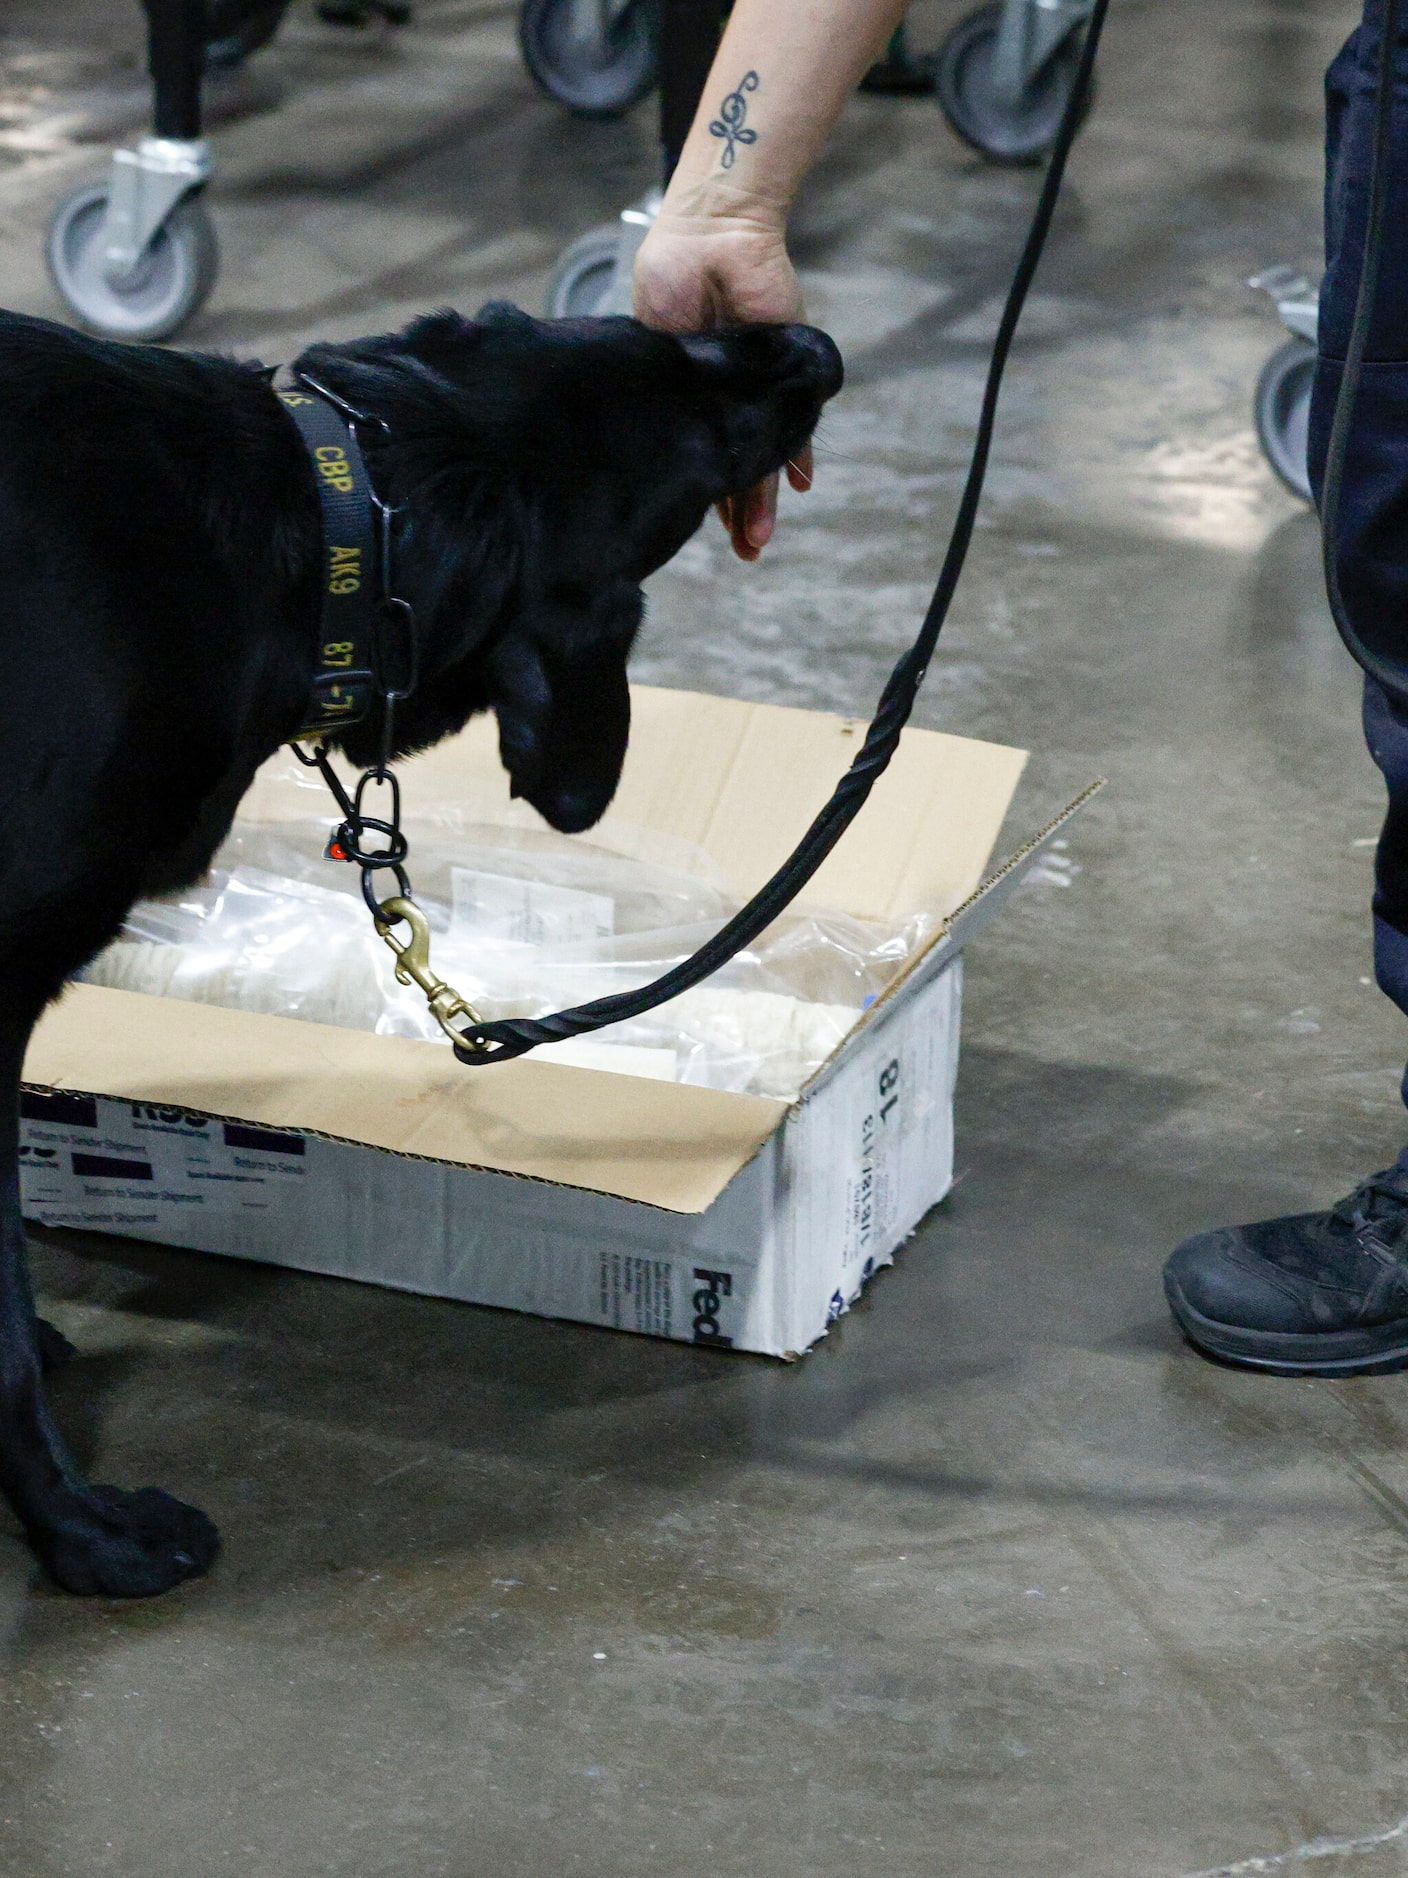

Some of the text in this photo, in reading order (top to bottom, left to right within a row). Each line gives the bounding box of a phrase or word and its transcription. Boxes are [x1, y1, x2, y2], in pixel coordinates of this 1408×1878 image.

[314, 446, 354, 493] CBP
[328, 546, 361, 595] AK9
[879, 1058, 899, 1124] 18
[693, 1267, 733, 1348] Fed
